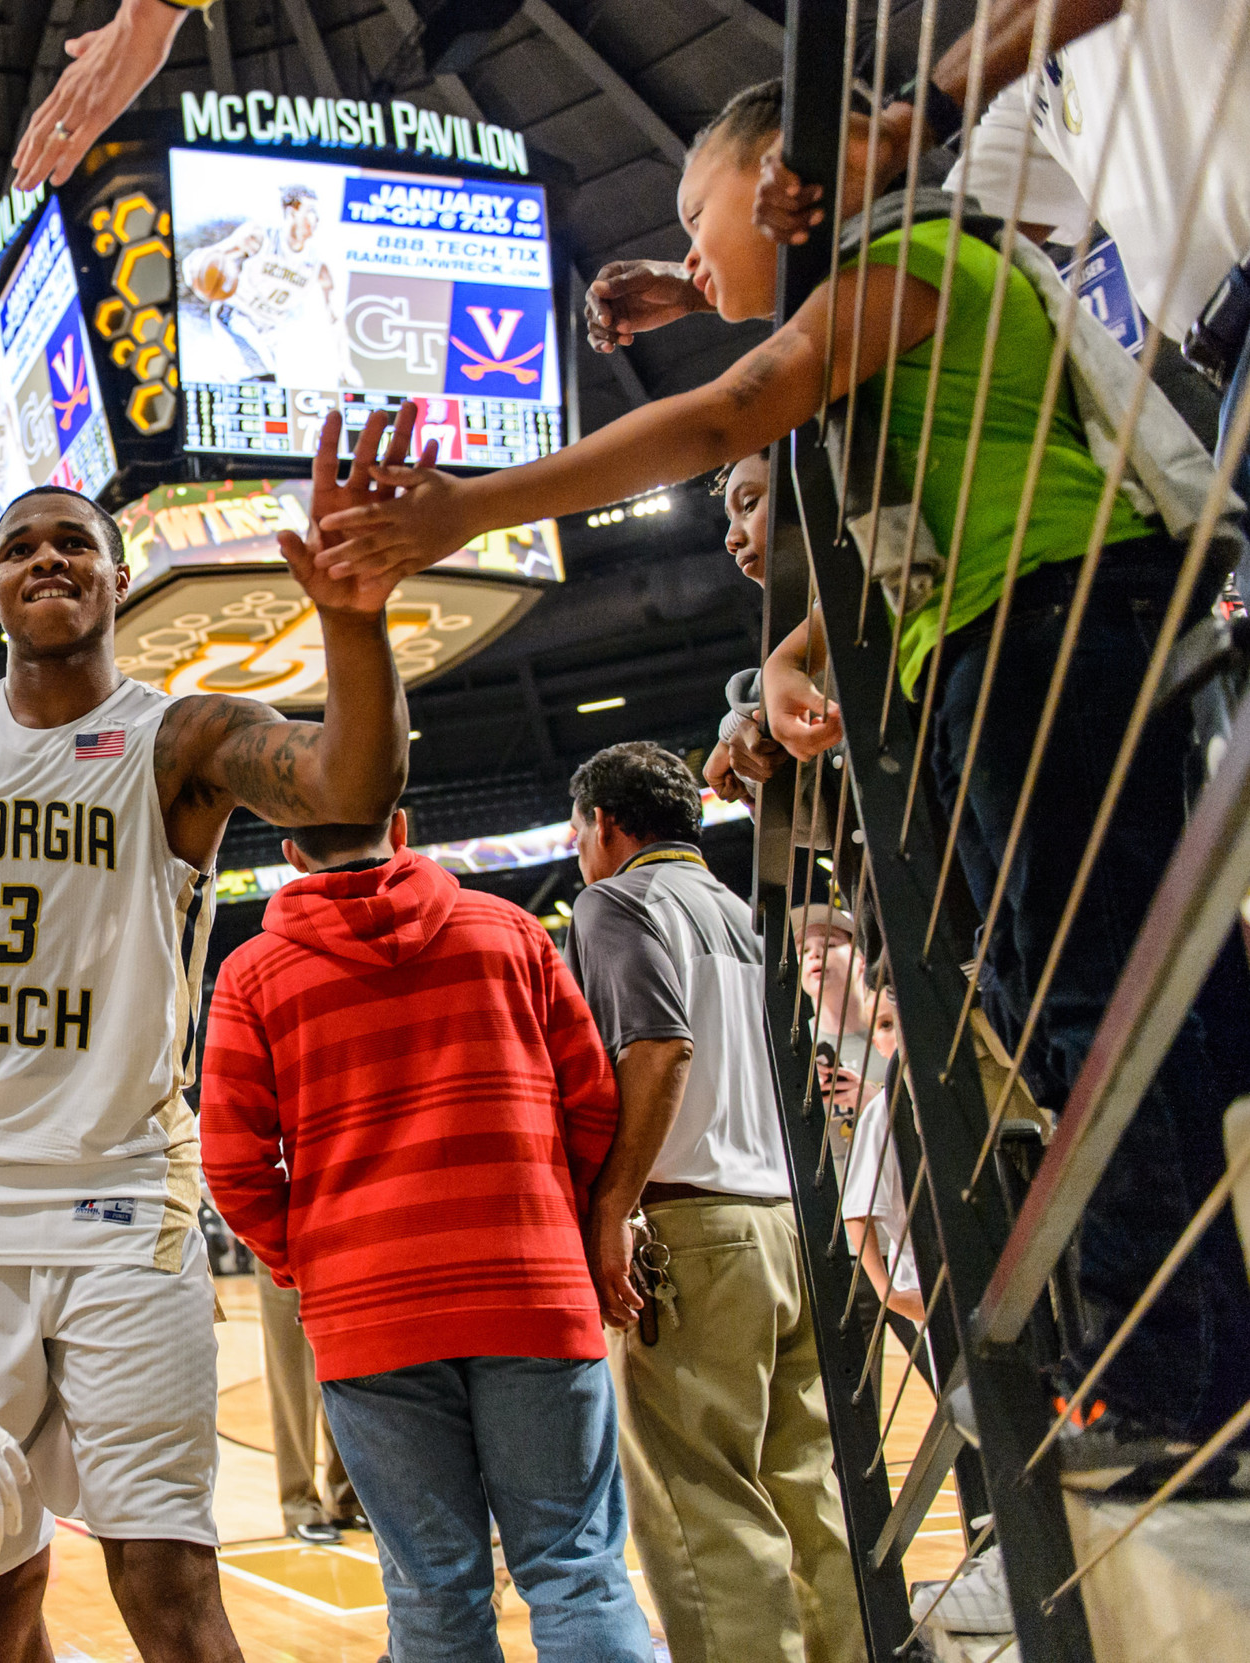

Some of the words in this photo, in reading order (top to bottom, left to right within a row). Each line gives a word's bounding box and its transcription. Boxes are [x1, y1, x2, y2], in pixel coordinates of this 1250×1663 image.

[391, 100, 529, 175] PAVILION
[348, 201, 438, 227] TIP-OFF
[459, 214, 512, 235] 7:00
[369, 184, 514, 219] JANUARY
[516, 199, 540, 222] 9
